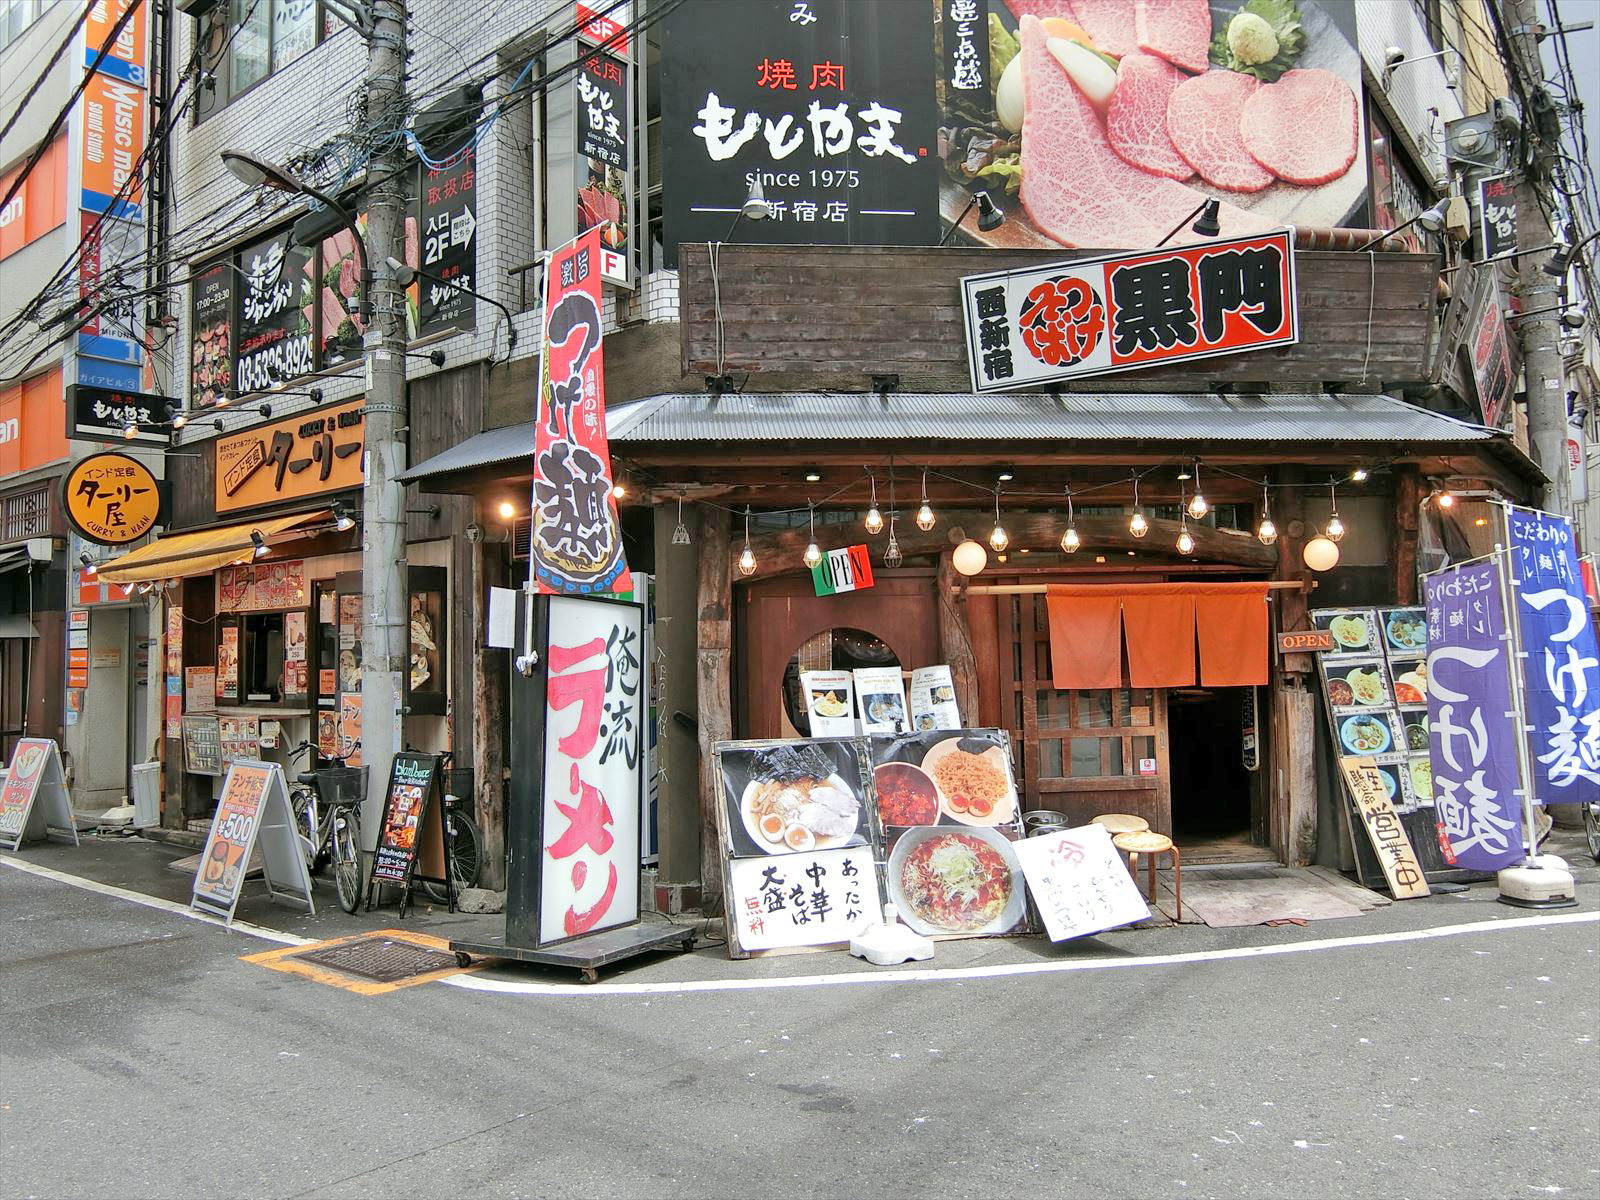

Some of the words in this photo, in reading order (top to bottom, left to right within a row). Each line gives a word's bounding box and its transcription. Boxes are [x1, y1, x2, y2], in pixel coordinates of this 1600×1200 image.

[789, 4, 818, 25] み
[128, 63, 143, 83] 3
[757, 58, 845, 91] 焼肉
[88, 102, 105, 134] sound
[103, 78, 139, 148] Music
[693, 92, 918, 164] もとやま
[87, 131, 105, 163] studio
[585, 141, 621, 165] 新宿店
[112, 148, 132, 197] man
[427, 170, 474, 206] 取扱店
[745, 168, 800, 187] since
[808, 169, 860, 188] 1975
[426, 212, 450, 236] 入口
[425, 233, 450, 265] 2F
[604, 252, 618, 275] F
[1111, 245, 1283, 354] 黒門
[974, 285, 1014, 381] 西新宿
[534, 290, 613, 563] つけ麺
[84, 467, 137, 479] インド定食
[75, 479, 151, 509] ターリー
[86, 520, 114, 537] CURRY
[120, 529, 127, 537] &
[130, 514, 151, 534] NAAN
[105, 501, 127, 526] 屋
[1513, 520, 1568, 546] こだわりの
[821, 551, 865, 589] OPEN
[1522, 546, 1534, 579] タレ
[1282, 634, 1331, 648] OPEN
[599, 623, 640, 771] 俺流
[544, 636, 619, 938] ラーメン
[759, 865, 787, 914] 大盛
[805, 861, 833, 923] 中華
[841, 857, 863, 922] あったか
[744, 896, 766, 936] 無料
